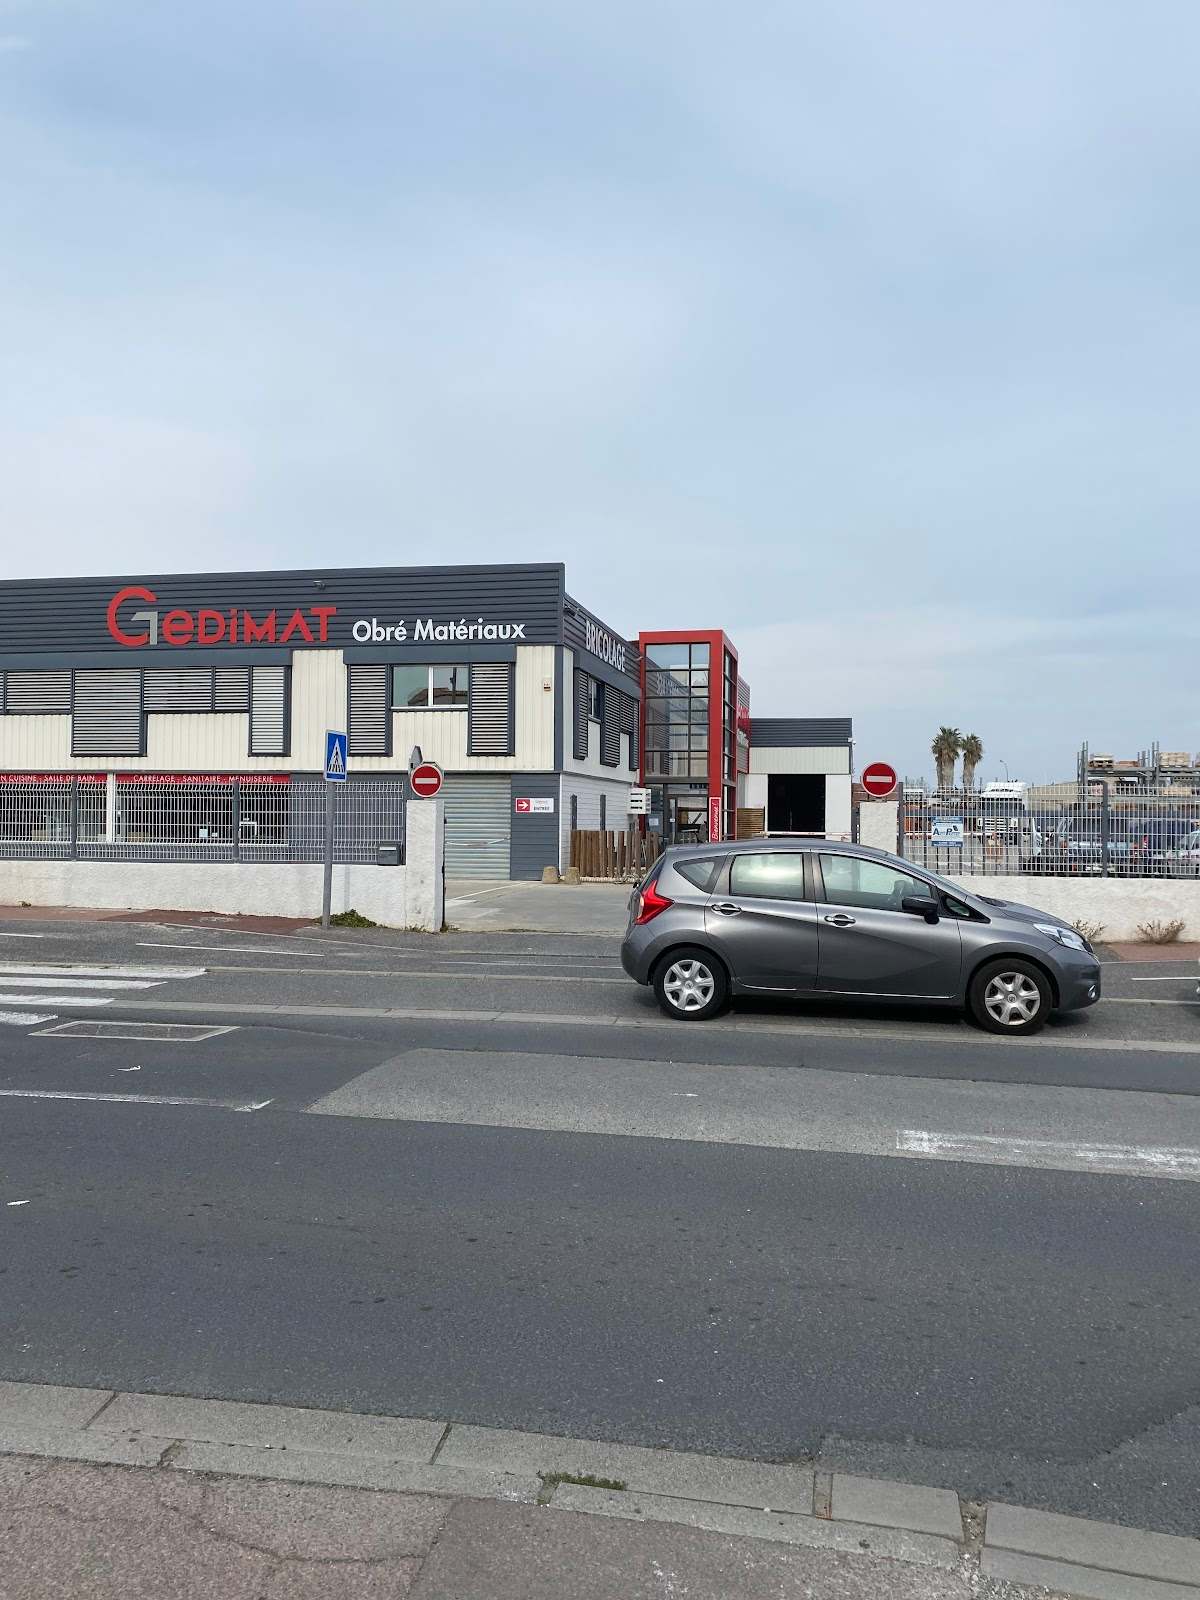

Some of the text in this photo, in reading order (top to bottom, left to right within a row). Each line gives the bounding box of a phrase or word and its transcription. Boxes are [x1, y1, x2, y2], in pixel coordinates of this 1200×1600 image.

[352, 617, 526, 642] Obré Matériaux
[586, 620, 625, 673] BRICOLAGE
[8, 774, 37, 782] CUISINE
[43, 774, 63, 782] SALLE
[77, 774, 95, 782] BAIN
